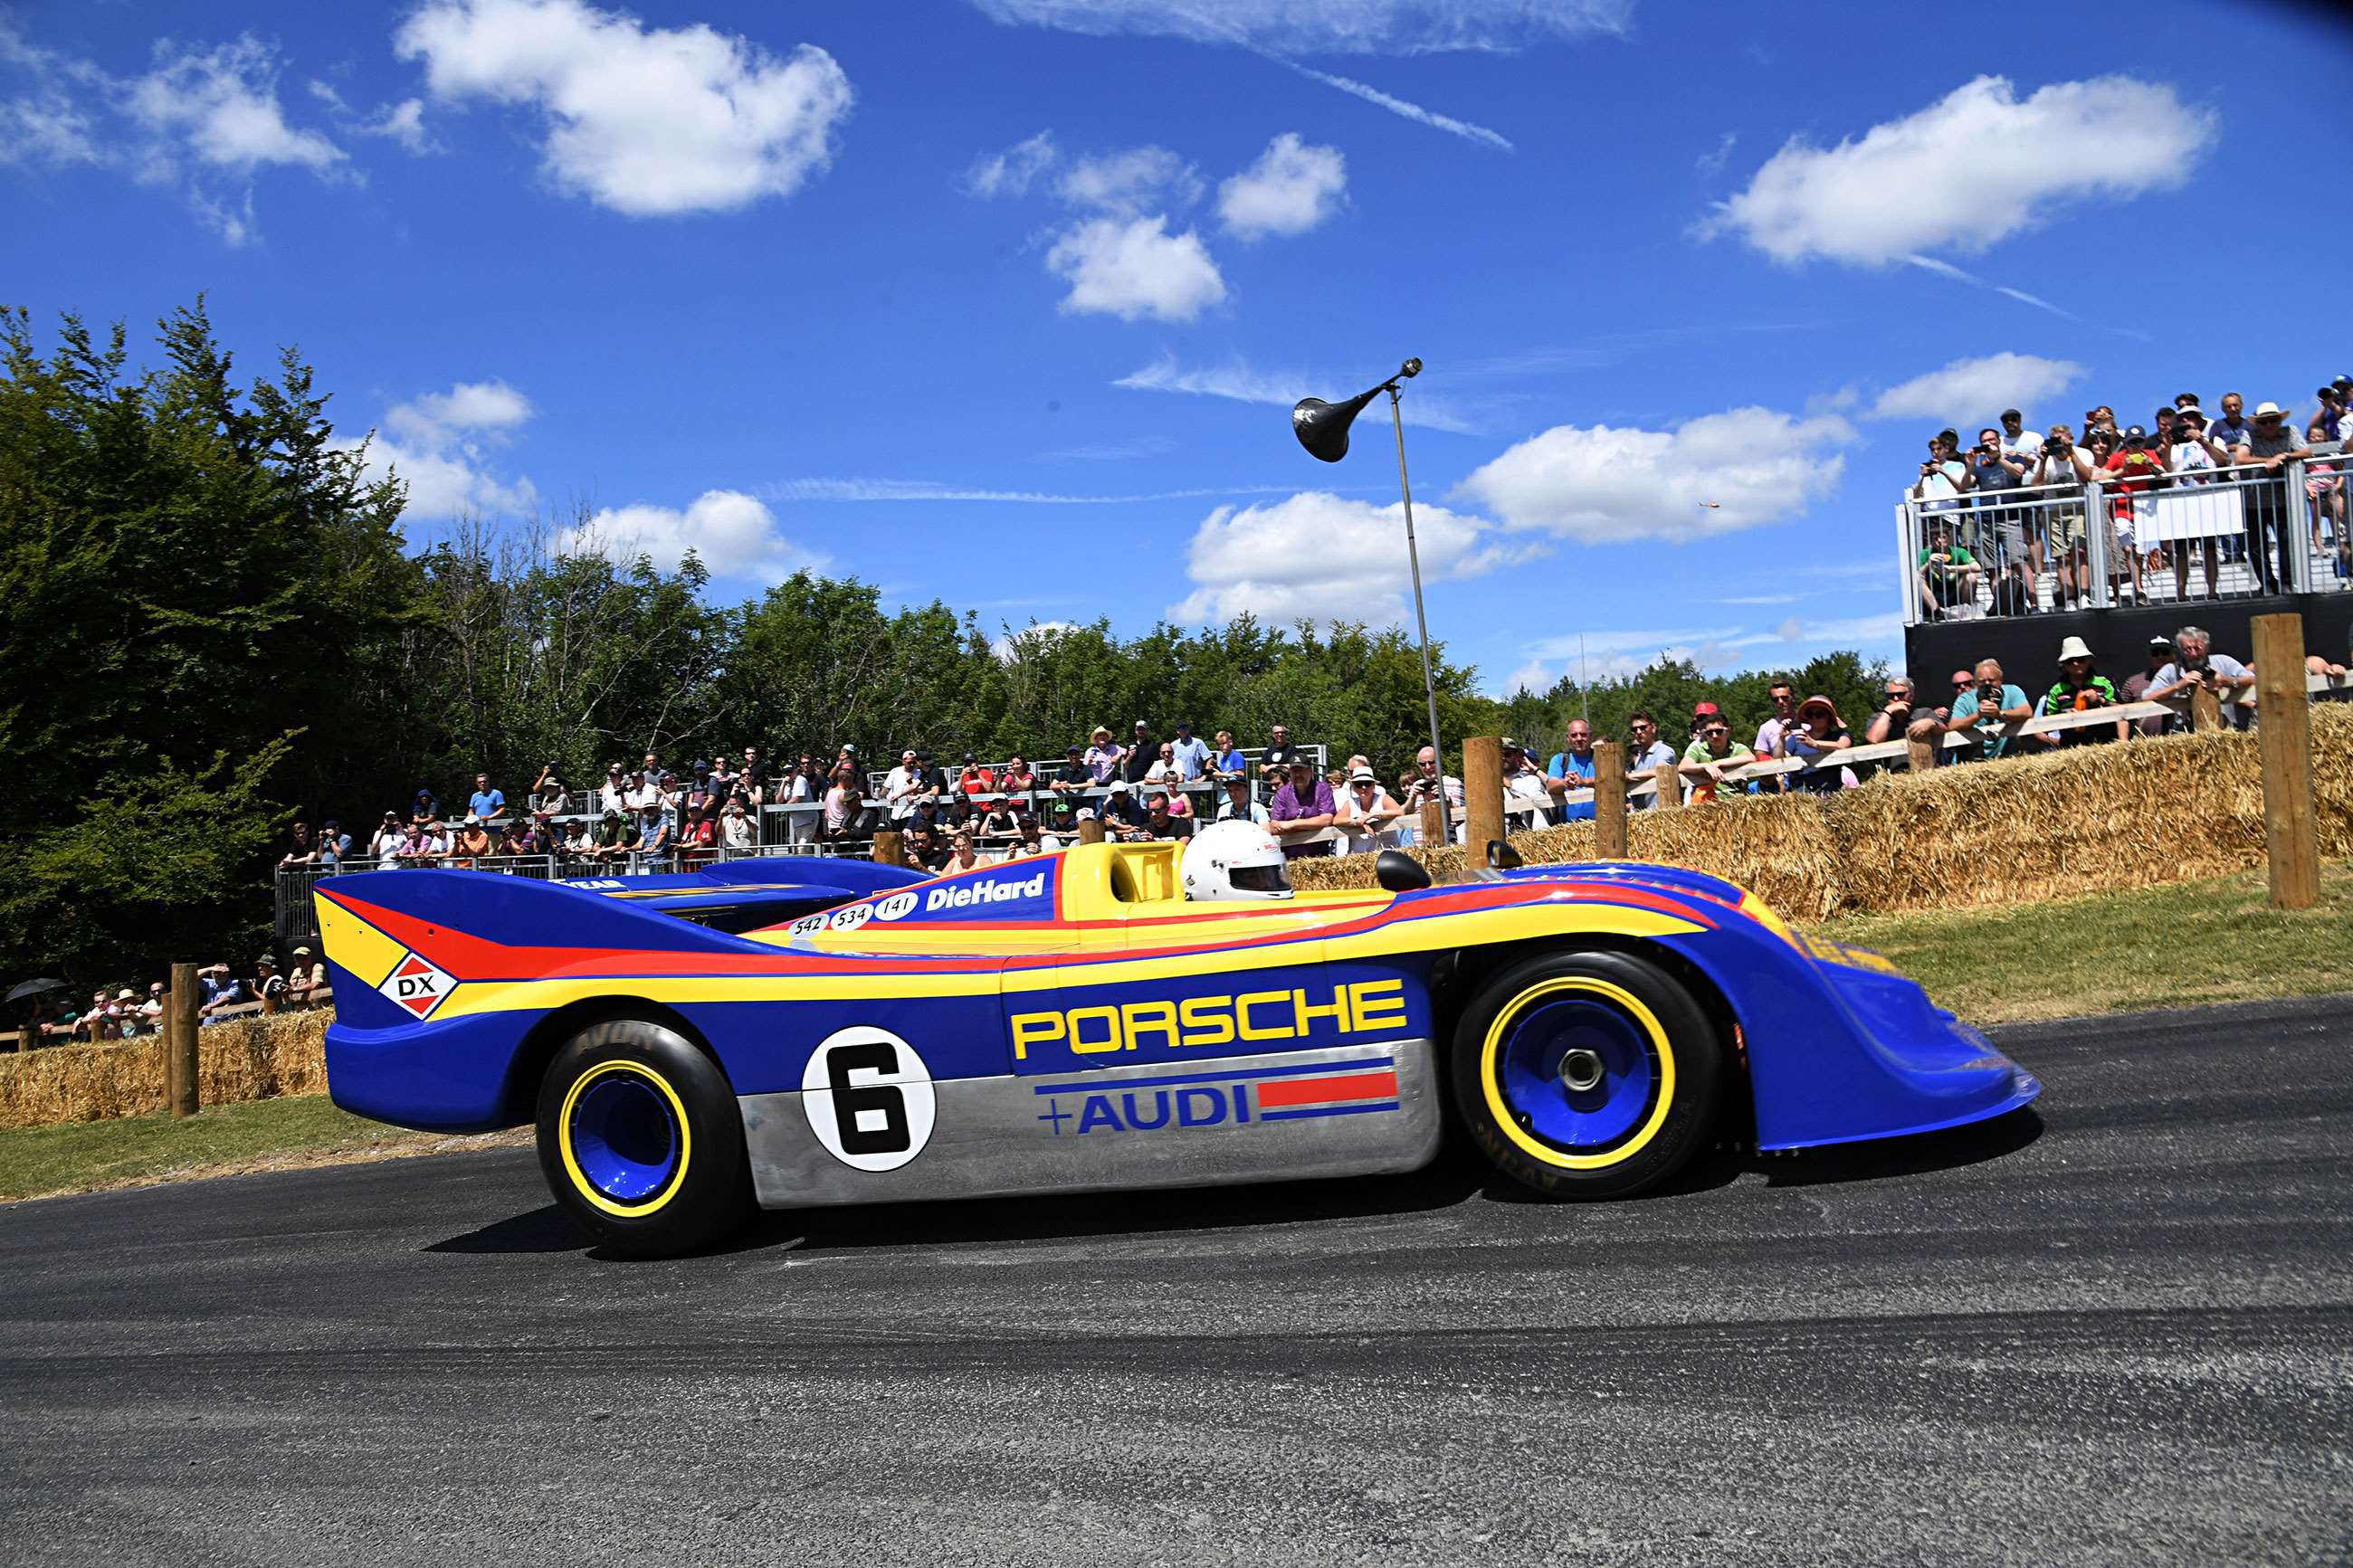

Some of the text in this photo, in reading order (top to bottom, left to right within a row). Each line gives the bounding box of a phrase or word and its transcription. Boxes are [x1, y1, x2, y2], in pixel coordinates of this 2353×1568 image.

[926, 872, 1045, 912] DieHard
[883, 897, 910, 915] 141
[795, 917, 822, 935] 542
[837, 908, 867, 927] 534
[397, 975, 436, 997] DX
[1011, 978, 1407, 1060] PORSCHE
[825, 1041, 911, 1156] 6
